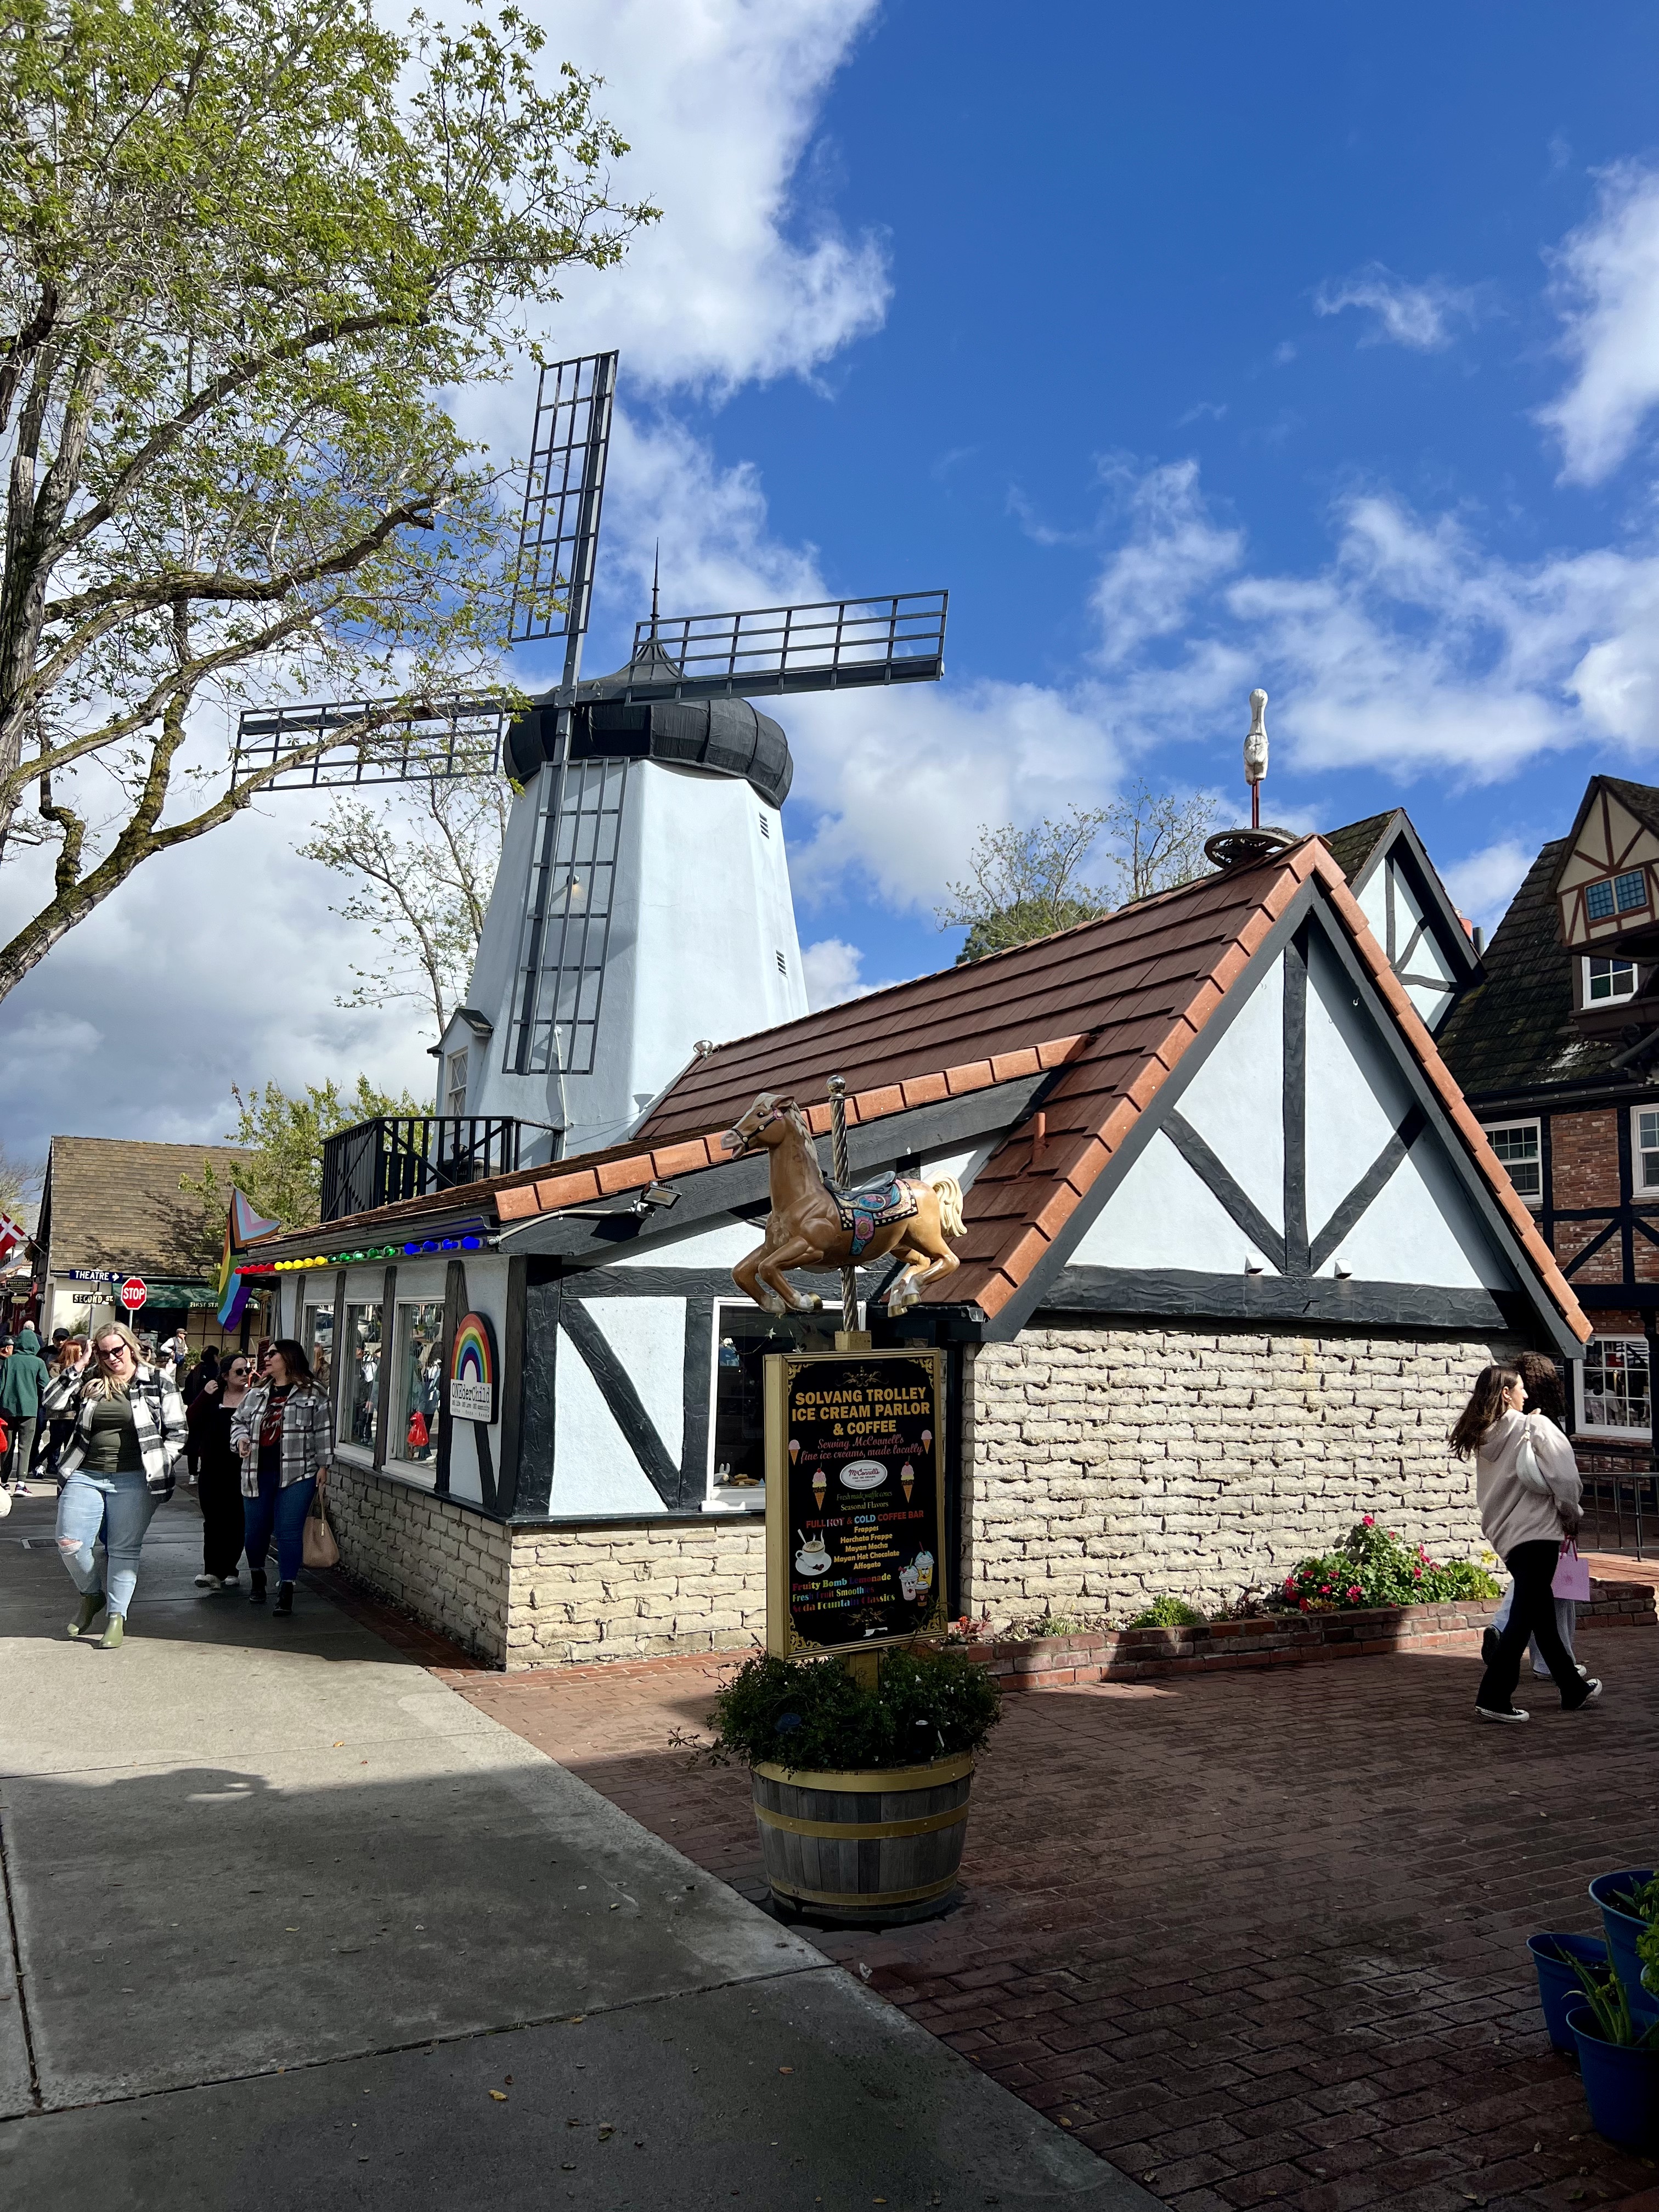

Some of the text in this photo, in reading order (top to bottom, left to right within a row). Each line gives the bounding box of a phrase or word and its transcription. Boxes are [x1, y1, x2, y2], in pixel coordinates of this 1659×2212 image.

[75, 1271, 109, 1280] THEATRE
[74, 1295, 102, 1304] SECOND
[123, 1288, 145, 1300] STOP
[452, 1383, 489, 1403] ONEderChild
[795, 1387, 926, 1405] SOLVANG TROLLEY
[792, 1402, 930, 1421] ICE CREAM PARLOR
[833, 1420, 896, 1436] & COFFEE
[818, 1434, 904, 1450] Serving McConnell's
[801, 1443, 923, 1464] fine ice creams, made locally
[865, 1491, 878, 1499] waffle
[841, 1502, 866, 1511] Seasonal
[806, 1519, 826, 1528] FULL
[827, 1517, 845, 1527] HOT
[854, 1514, 876, 1524] COLD
[877, 1511, 906, 1522] COFFEE
[908, 1510, 924, 1519] BAR
[854, 1526, 879, 1534] Frappes
[840, 1533, 893, 1544] Horchata Frappe
[845, 1544, 867, 1553] Mayan
[834, 1550, 900, 1564] Mayan Hot Chocolate
[853, 1561, 881, 1570] Affogato
[793, 1573, 891, 1592] Fruity Bomb Lemonade
[793, 1587, 874, 1602] Fresh Fruit Smoothies
[793, 1594, 895, 1612] Soda Fountain Classics
